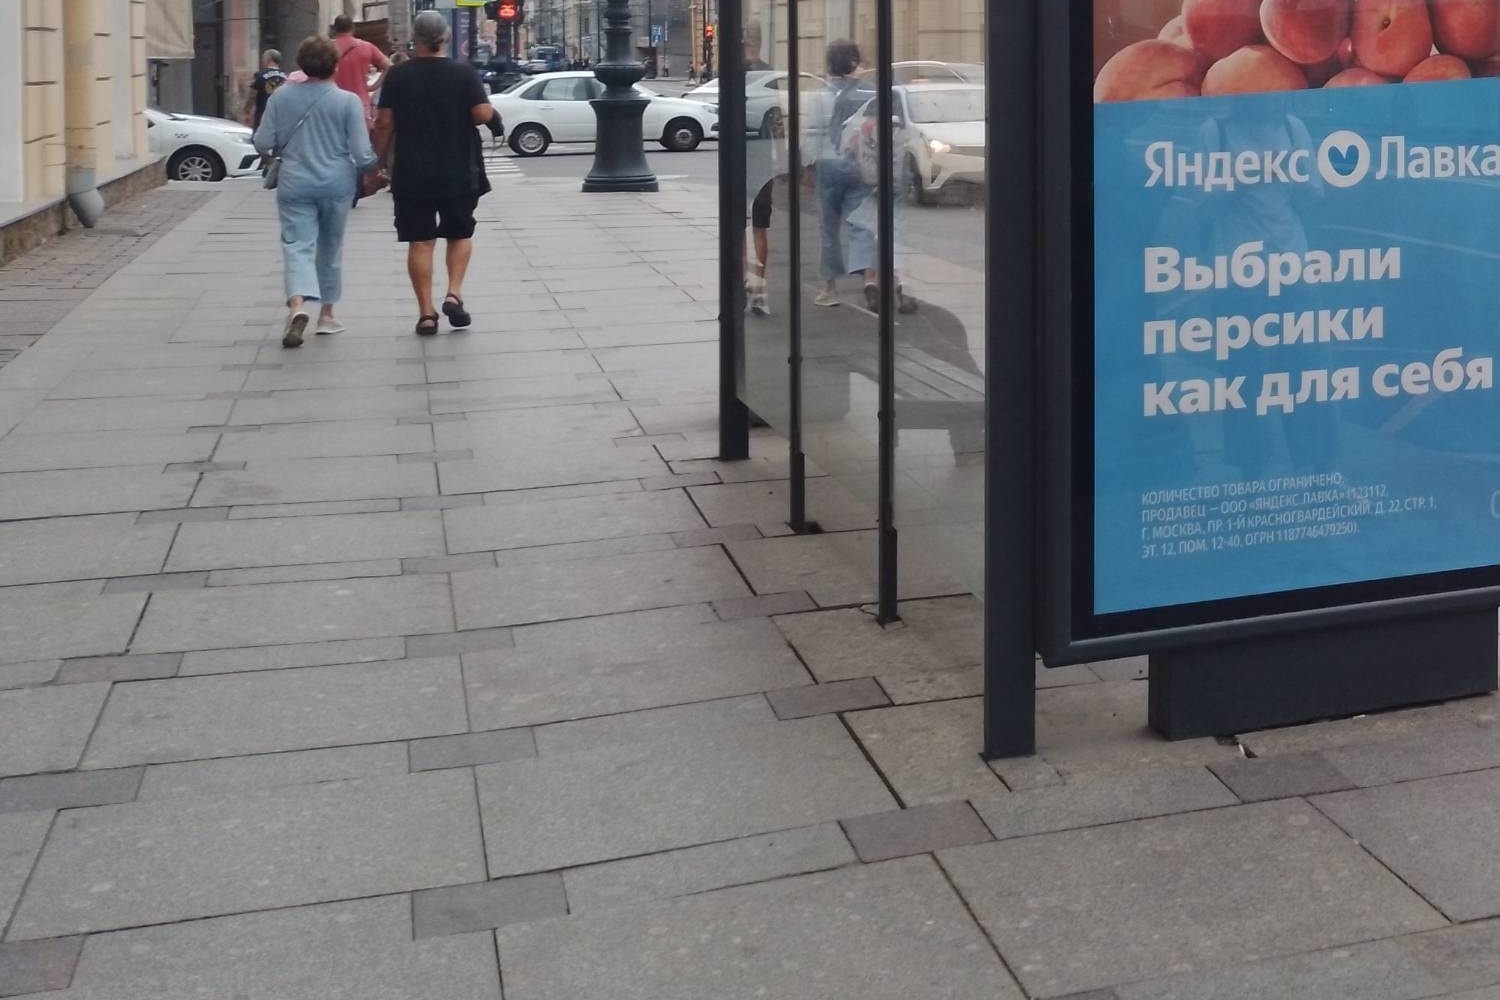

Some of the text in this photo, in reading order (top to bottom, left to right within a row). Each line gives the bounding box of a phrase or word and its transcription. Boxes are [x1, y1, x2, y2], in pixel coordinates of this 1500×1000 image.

[1144, 141, 1310, 192] Яндекс
[1144, 240, 1402, 297] Выбрали
[1143, 305, 1385, 361] персики
[1143, 346, 1494, 417] как для себя
[1142, 485, 1220, 505] КОЛИЧЕСТВО
[1221, 480, 1267, 497] ТОВАРА
[1142, 503, 1207, 523] ПРОДАВЕЦ
[1220, 499, 1248, 514] ООО
